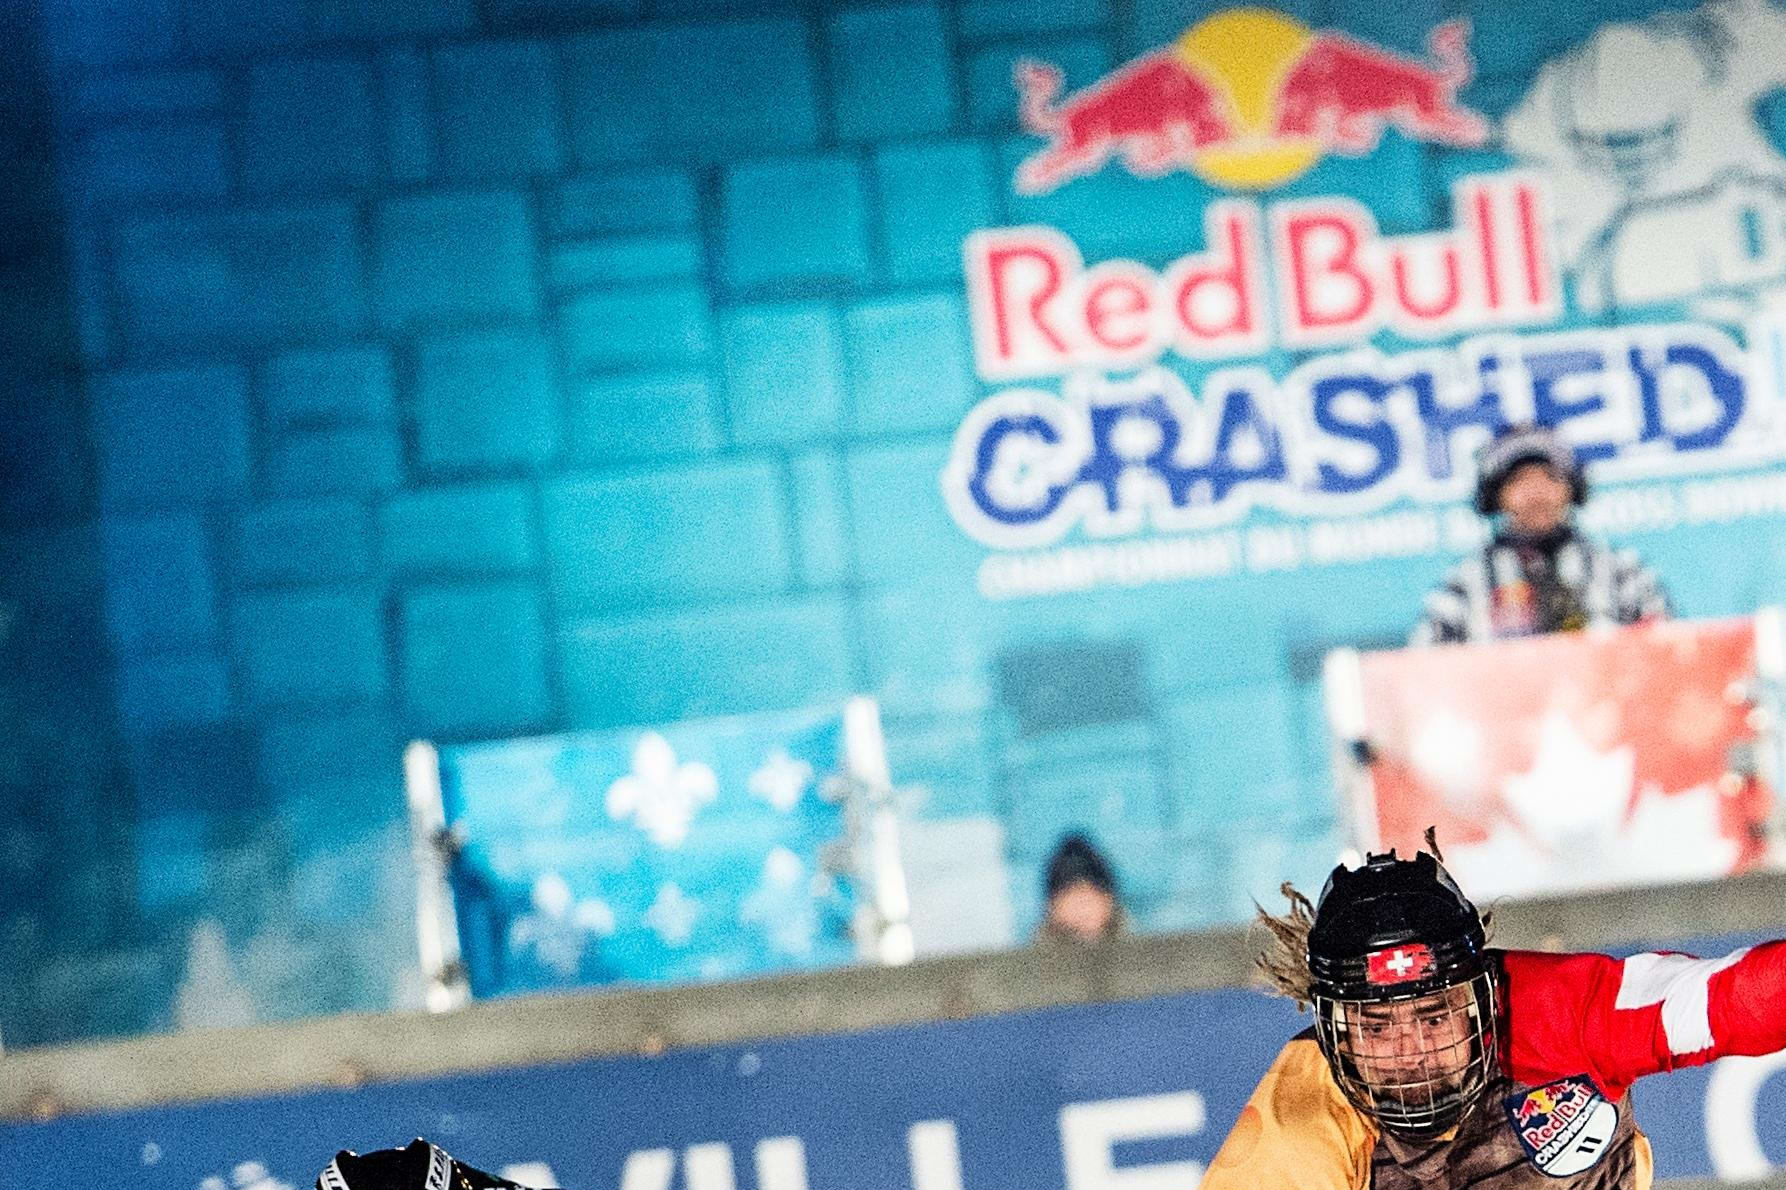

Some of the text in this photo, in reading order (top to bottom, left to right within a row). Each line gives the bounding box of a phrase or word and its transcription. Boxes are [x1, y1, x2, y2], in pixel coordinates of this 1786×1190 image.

[984, 186, 1548, 358] Red Bull
[970, 343, 1748, 523] CRASHED
[1523, 1111, 1567, 1150] Red
[1557, 1084, 1594, 1120] Bull
